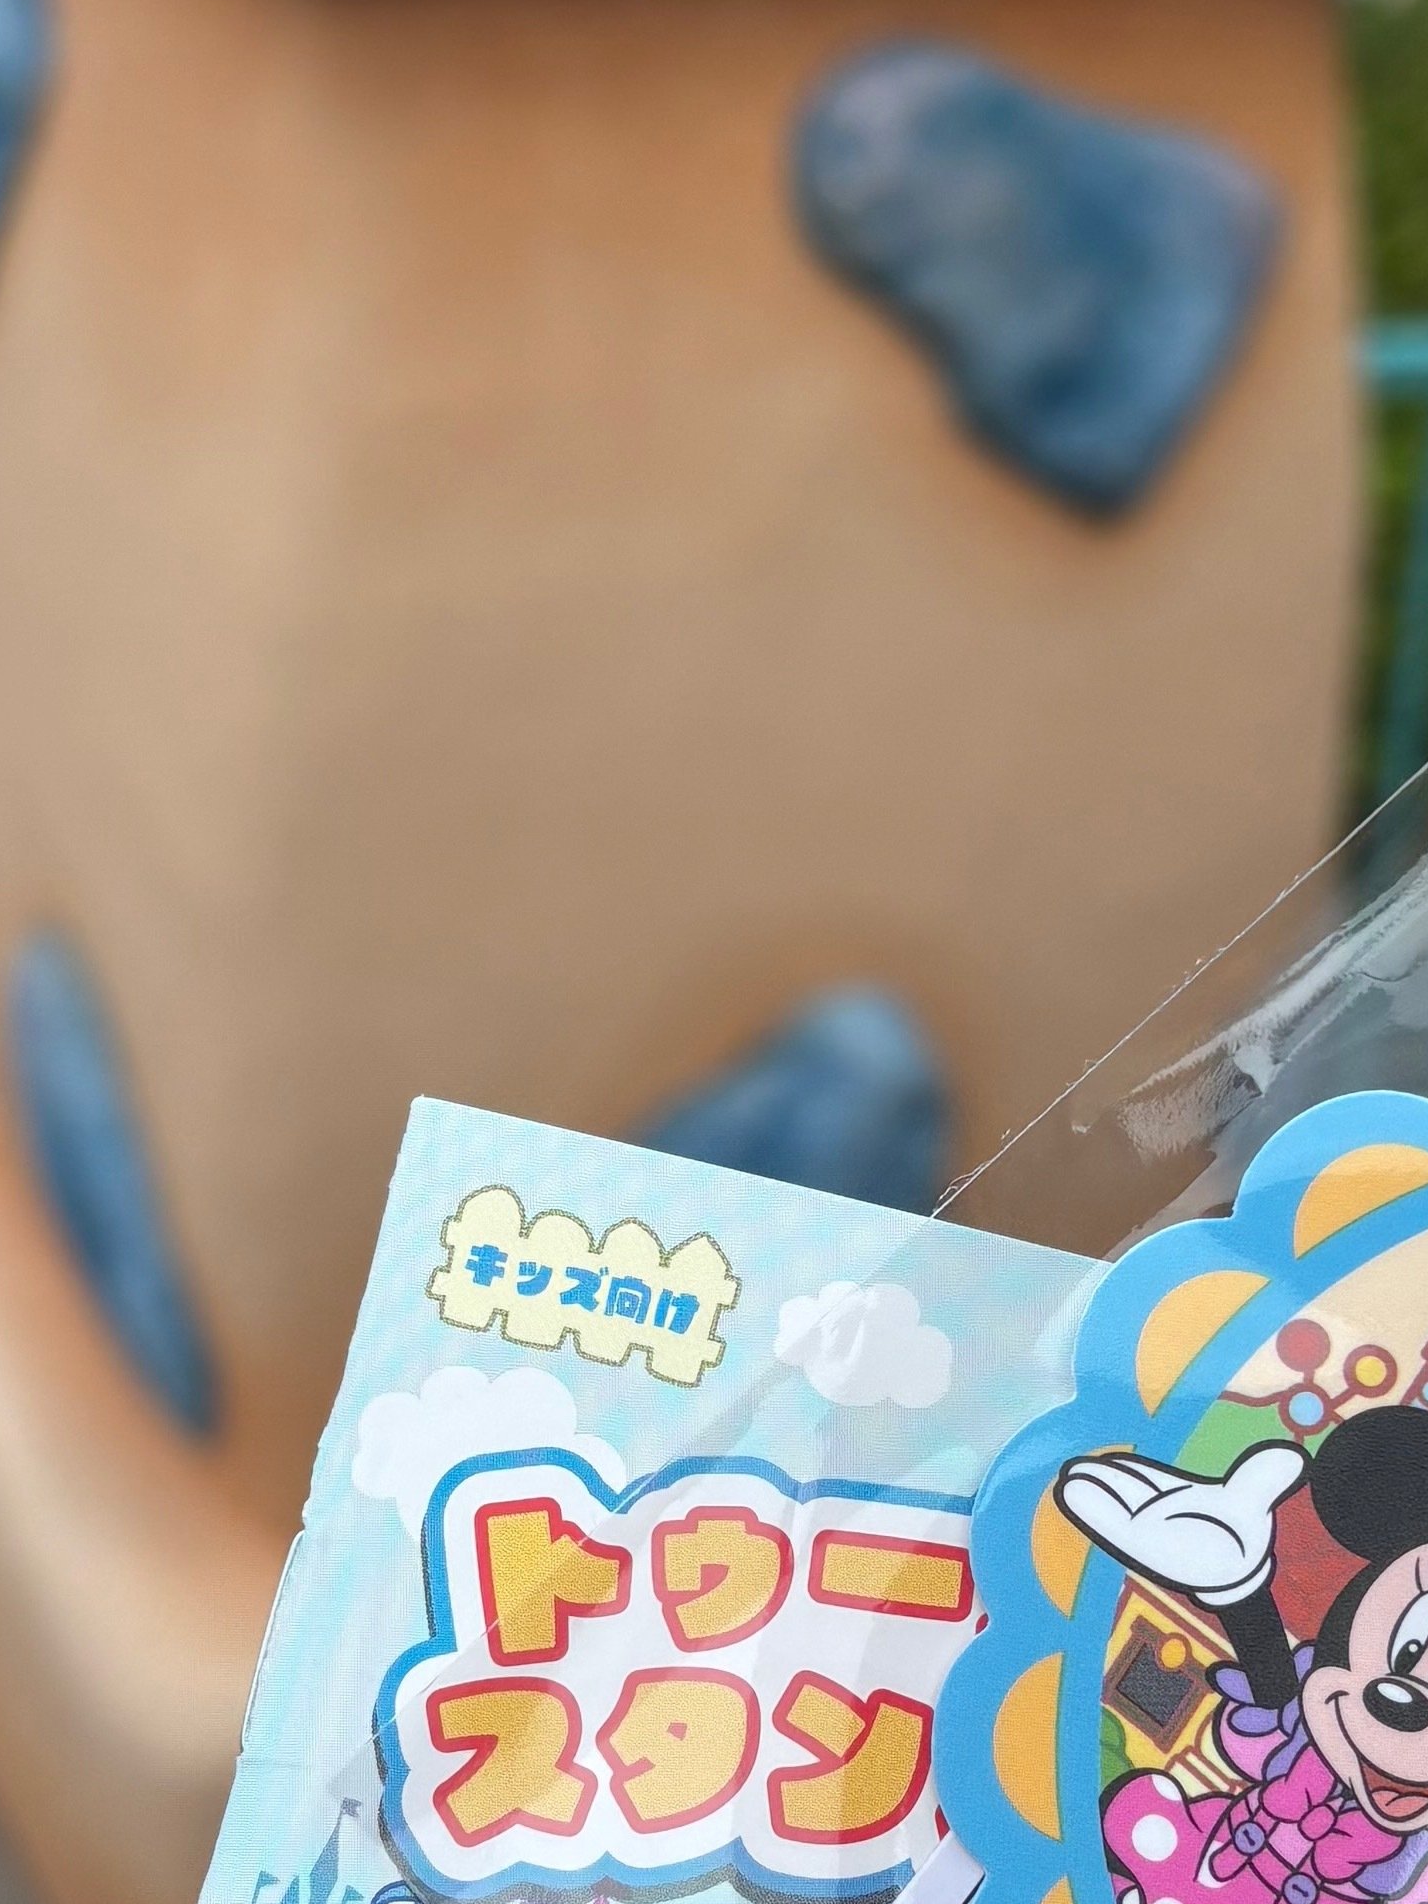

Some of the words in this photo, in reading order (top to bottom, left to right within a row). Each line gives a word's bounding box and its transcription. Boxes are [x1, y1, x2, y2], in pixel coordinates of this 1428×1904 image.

[465, 1242, 700, 1336] キッズ向け
[474, 1496, 989, 1666] トゥー
[425, 1666, 950, 1848] スタン
